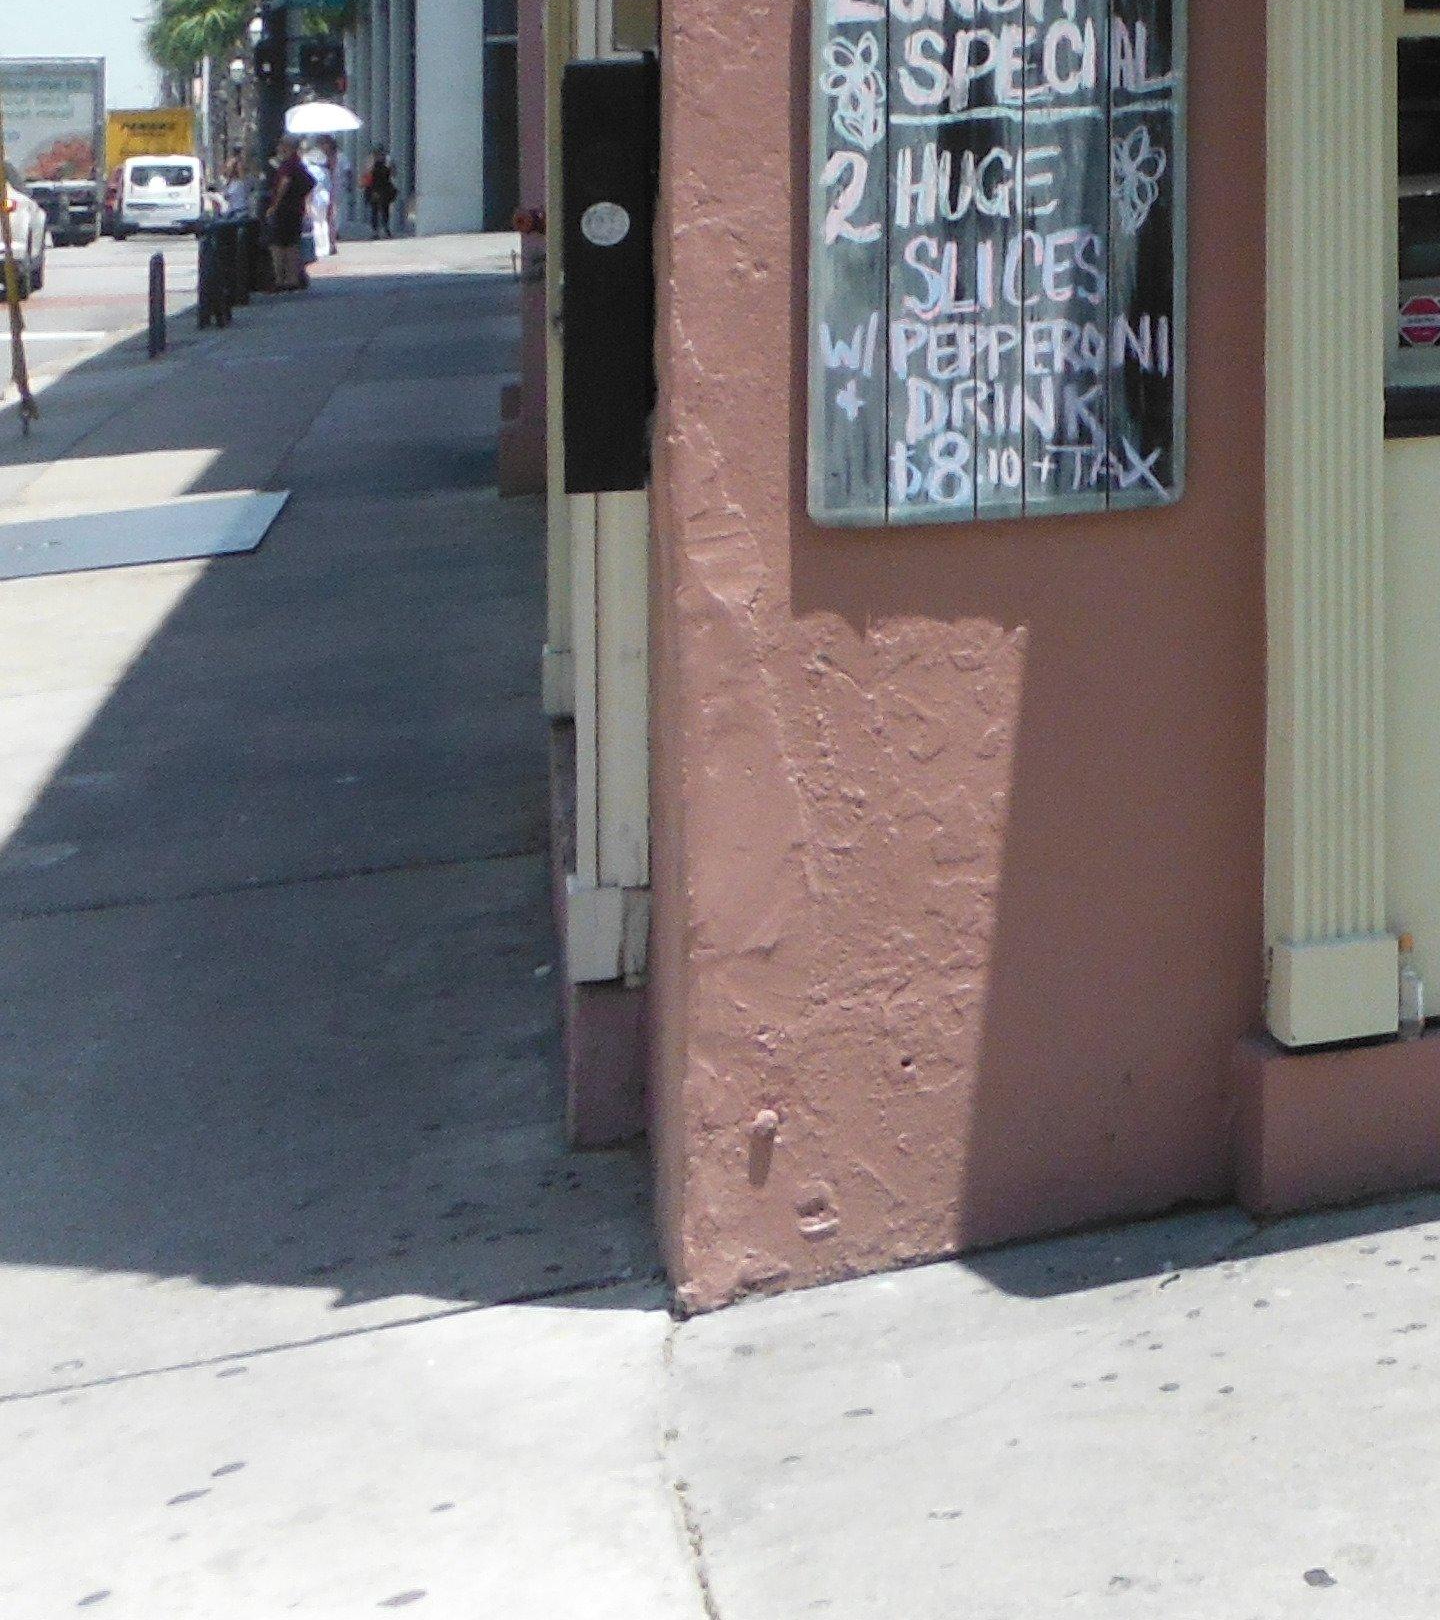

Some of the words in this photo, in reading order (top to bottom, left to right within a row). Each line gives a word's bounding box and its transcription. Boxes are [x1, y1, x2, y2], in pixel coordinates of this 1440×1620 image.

[898, 17, 1177, 112] SPECIAL
[819, 150, 883, 245] 2
[894, 143, 1062, 228] HUGE
[903, 229, 1107, 320] SLICES
[890, 314, 1170, 381] PEPPERONI
[905, 377, 1106, 448] DRINK
[1046, 437, 1172, 500] TAX
